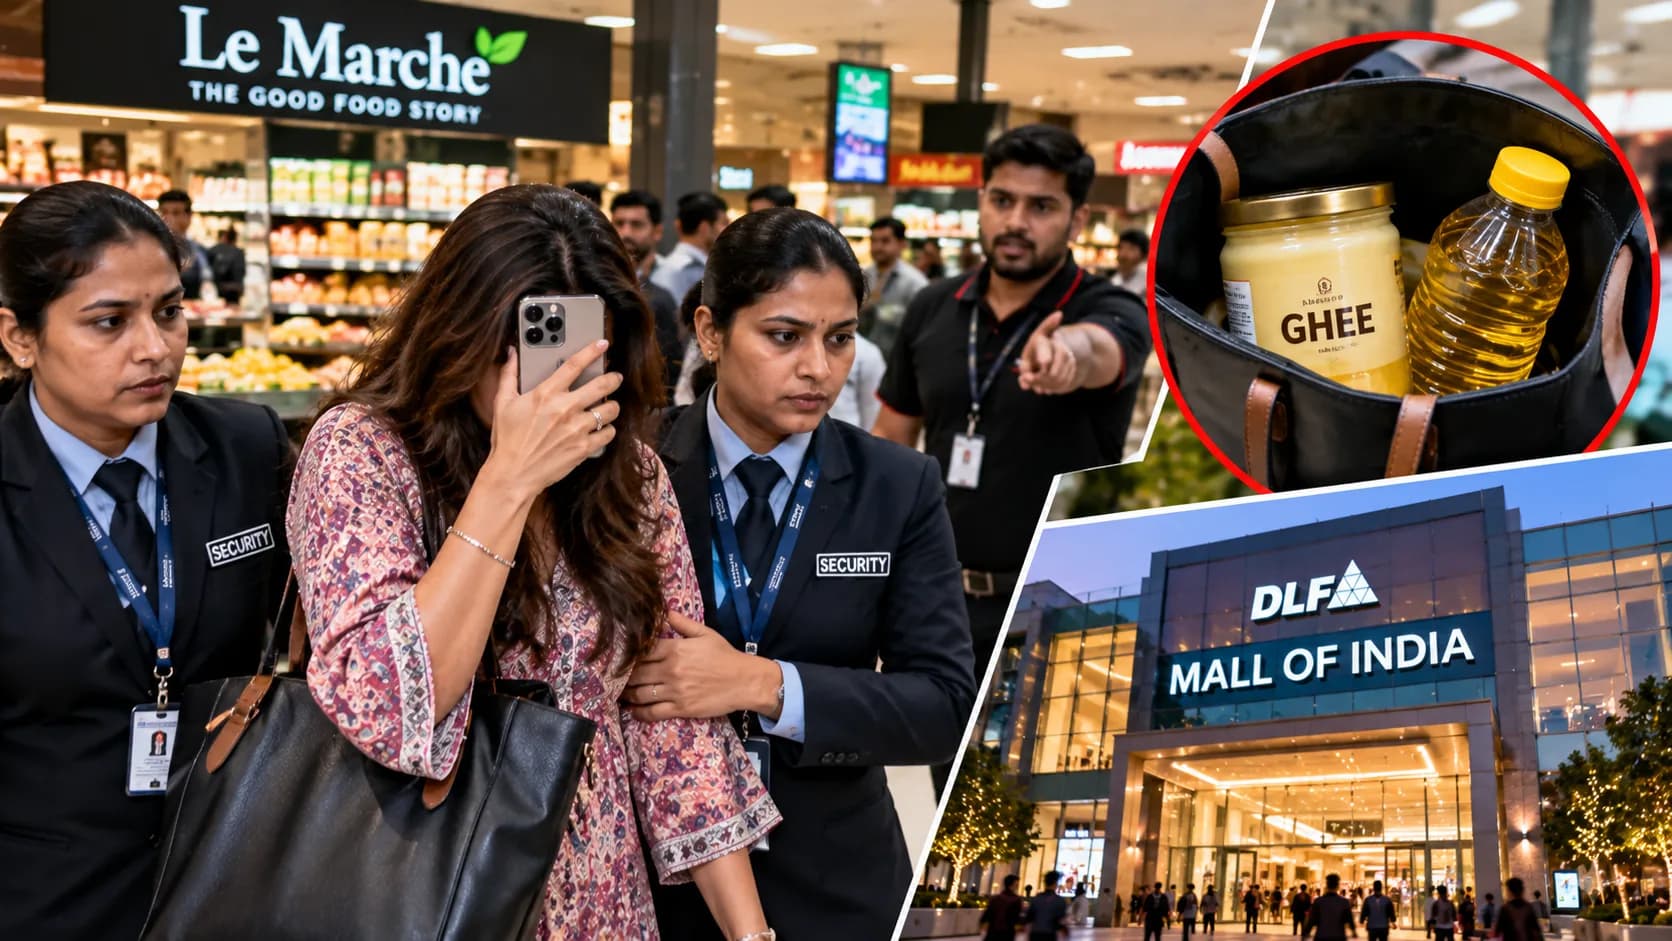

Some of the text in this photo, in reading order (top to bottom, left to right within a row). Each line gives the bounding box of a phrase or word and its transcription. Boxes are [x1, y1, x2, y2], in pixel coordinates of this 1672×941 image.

[179, 5, 491, 96] Le Marche
[188, 80, 482, 124] THE GOOD FOOD STORY
[1280, 302, 1376, 345] GHEE
[211, 530, 270, 562] SECURITY
[819, 556, 888, 574] SECURITY
[1250, 574, 1336, 621] DLF
[1169, 627, 1474, 695] MALL OF INDIA
